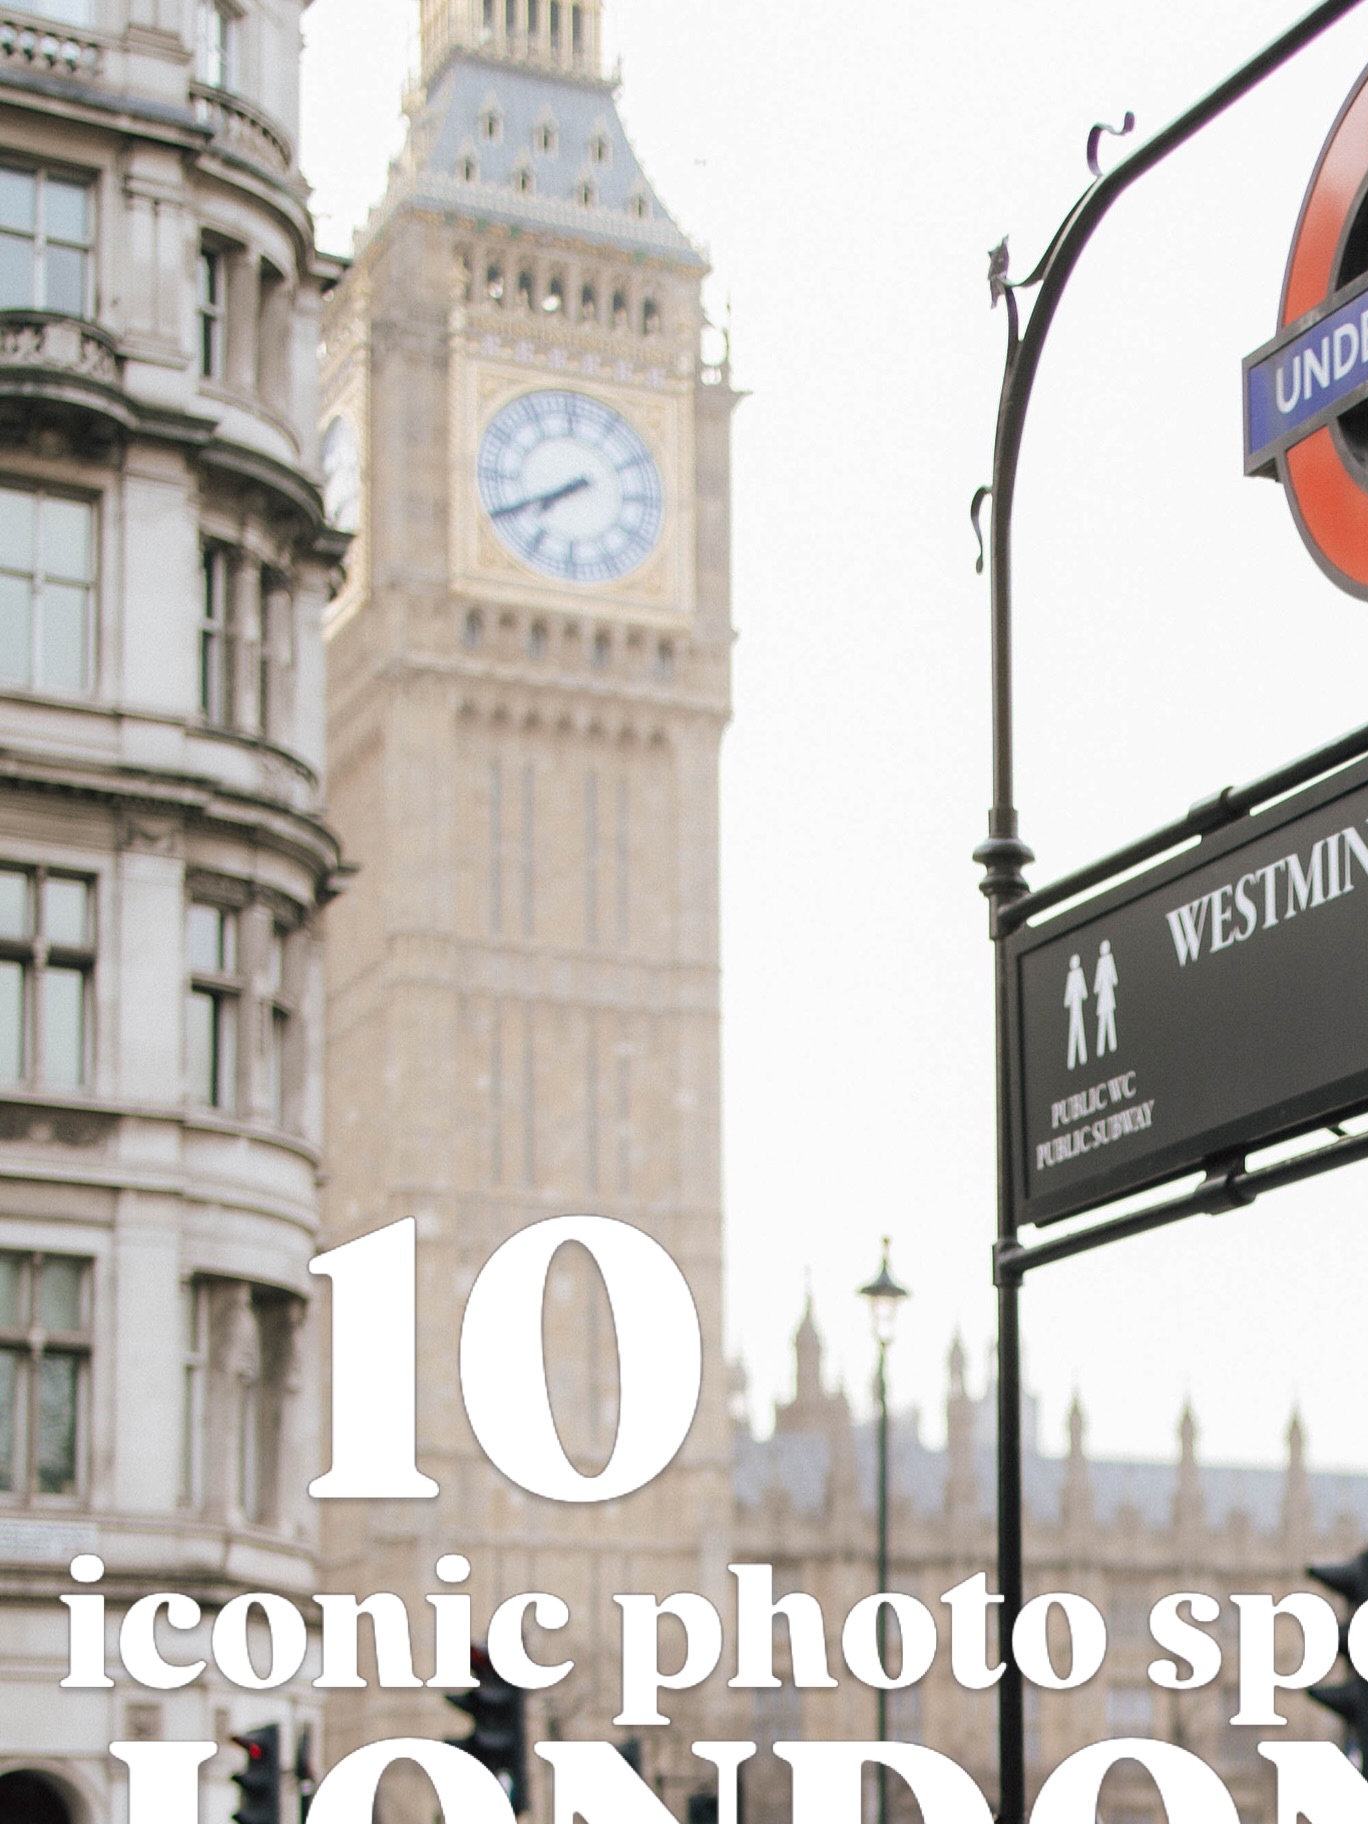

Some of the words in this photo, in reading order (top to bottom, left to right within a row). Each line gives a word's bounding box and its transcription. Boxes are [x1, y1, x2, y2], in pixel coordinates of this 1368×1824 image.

[1051, 1082, 1108, 1129] PUBLIC
[1106, 1070, 1137, 1104] WC
[1036, 1125, 1091, 1171] PUBLIC
[1091, 1099, 1155, 1149] SUBWAY
